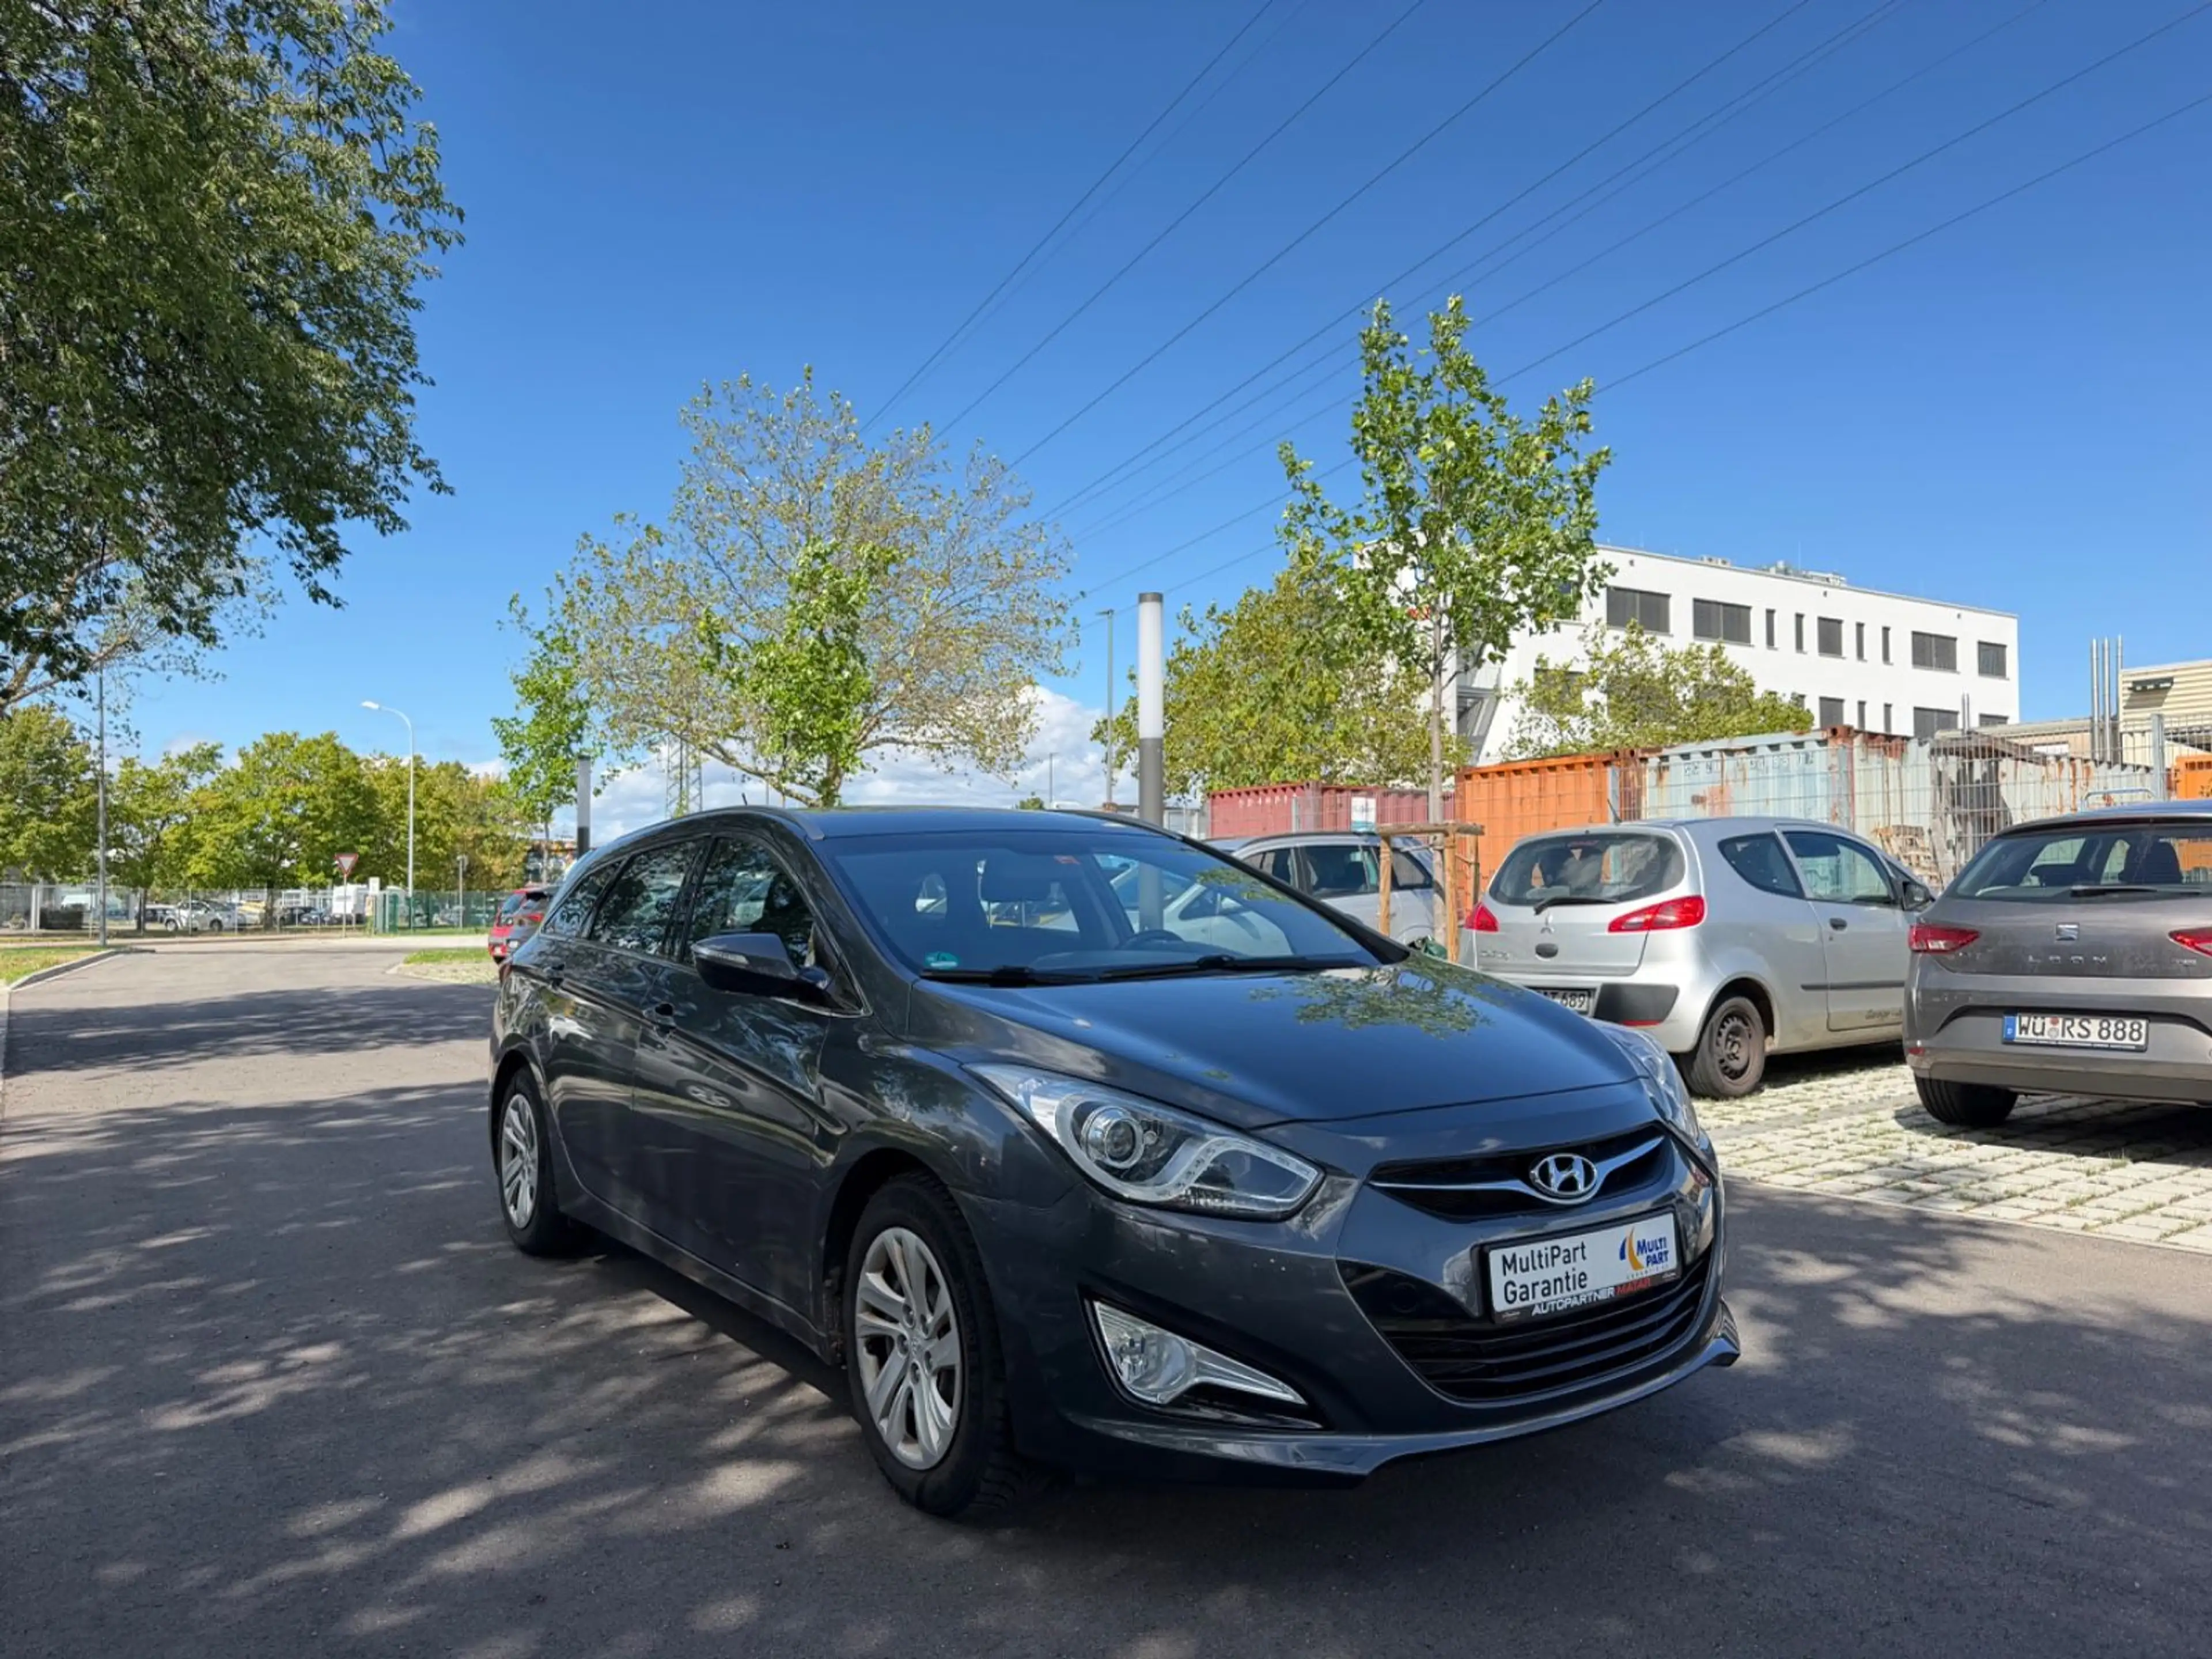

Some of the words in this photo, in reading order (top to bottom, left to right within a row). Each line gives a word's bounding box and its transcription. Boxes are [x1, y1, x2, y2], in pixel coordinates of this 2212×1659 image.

[2018, 1014, 2046, 1036] WÜ
[2061, 1017, 2091, 1039] RS
[2097, 1018, 2142, 1041] 888
[1502, 1241, 1587, 1277] MultiPart
[1637, 1236, 1666, 1256] MULTI
[1646, 1250, 1669, 1267] PART
[1503, 1267, 1587, 1305] Garantie
